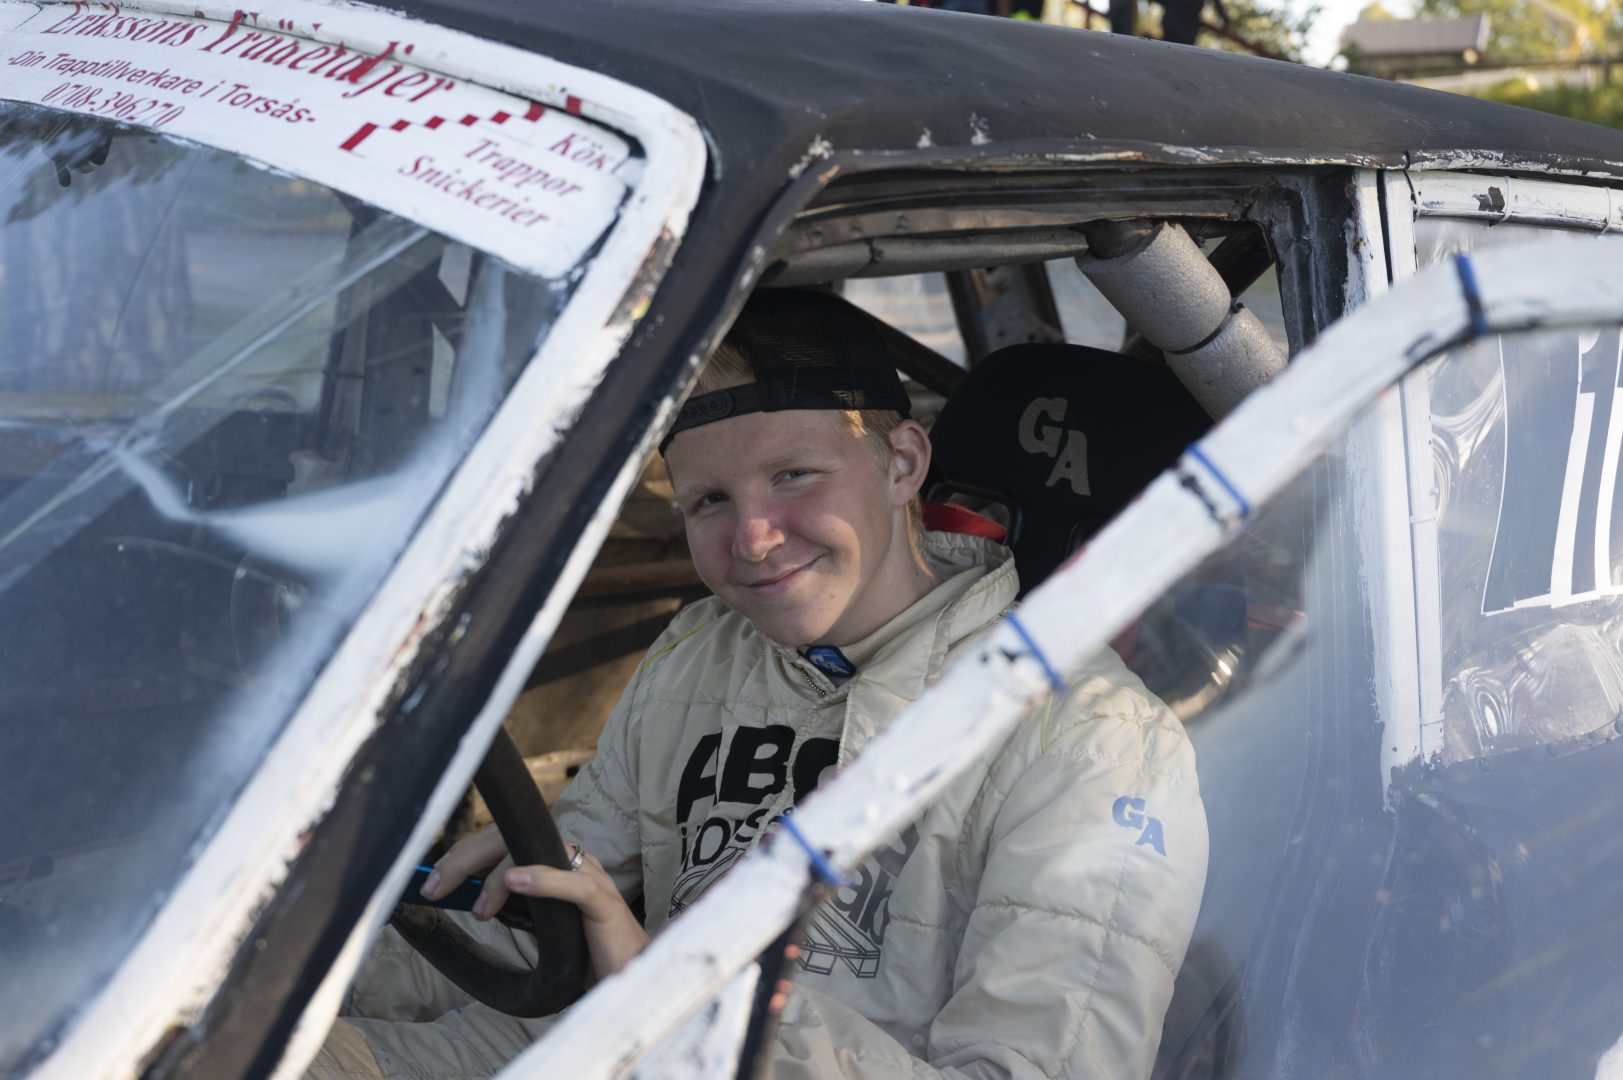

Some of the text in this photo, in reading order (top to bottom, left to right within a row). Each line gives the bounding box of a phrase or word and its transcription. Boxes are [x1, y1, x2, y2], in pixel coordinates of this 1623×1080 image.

[40, 0, 208, 47] Erikssons
[43, 53, 204, 94] Trapptillverkare
[200, 80, 226, 98] i
[41, 82, 186, 128] 0708-396270
[464, 137, 585, 198] Trappor
[549, 132, 613, 171] Kök
[398, 154, 552, 228] Snickerier
[1018, 396, 1092, 497] GA
[1111, 795, 1168, 857] GA
